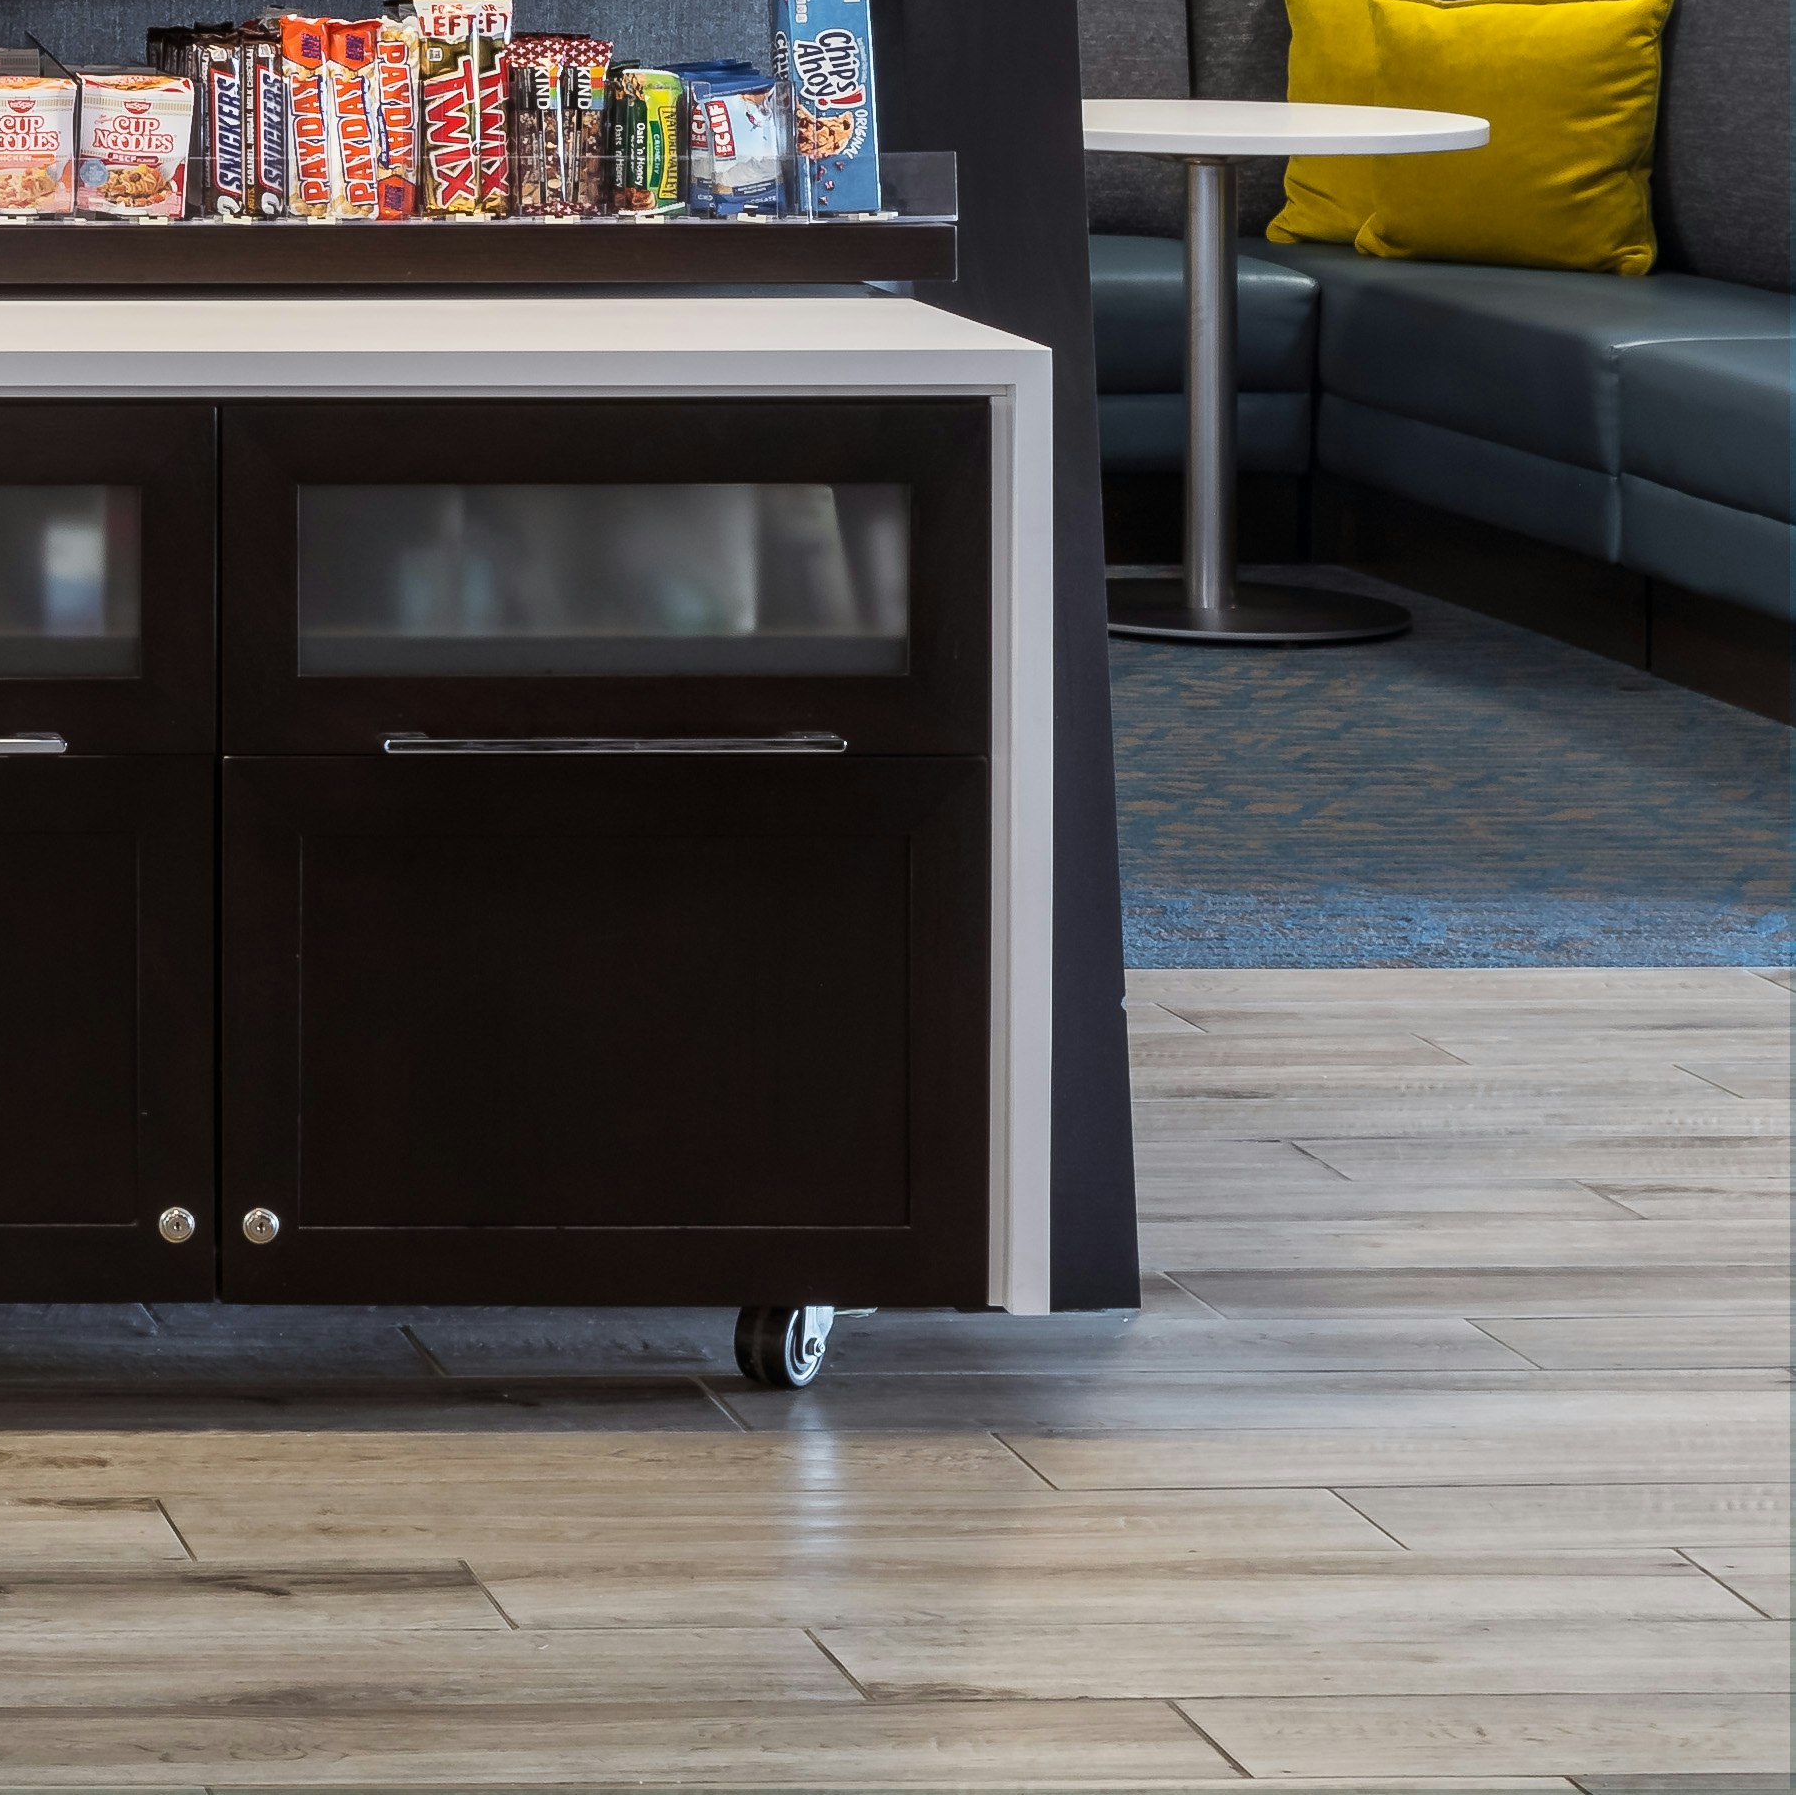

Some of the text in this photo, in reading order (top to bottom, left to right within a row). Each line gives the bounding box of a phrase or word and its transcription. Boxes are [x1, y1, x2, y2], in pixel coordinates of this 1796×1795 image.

[419, 14, 474, 36] LEFT
[820, 31, 859, 92] Chips
[536, 66, 550, 109] KIND
[577, 66, 592, 109] KIND
[93, 130, 174, 153] NOODLES
[113, 116, 160, 134] CUP
[217, 75, 243, 192] SNICKERS
[263, 75, 283, 190] SNICKERS
[291, 75, 330, 204] PAYDAY
[334, 76, 376, 206] PAYDAY
[424, 58, 476, 209] TWIX
[615, 125, 623, 145] Oats
[636, 122, 645, 144] Oats
[709, 103, 729, 144] CLIF
[845, 109, 869, 159] ORIGINAL
[716, 145, 733, 154] BAR
